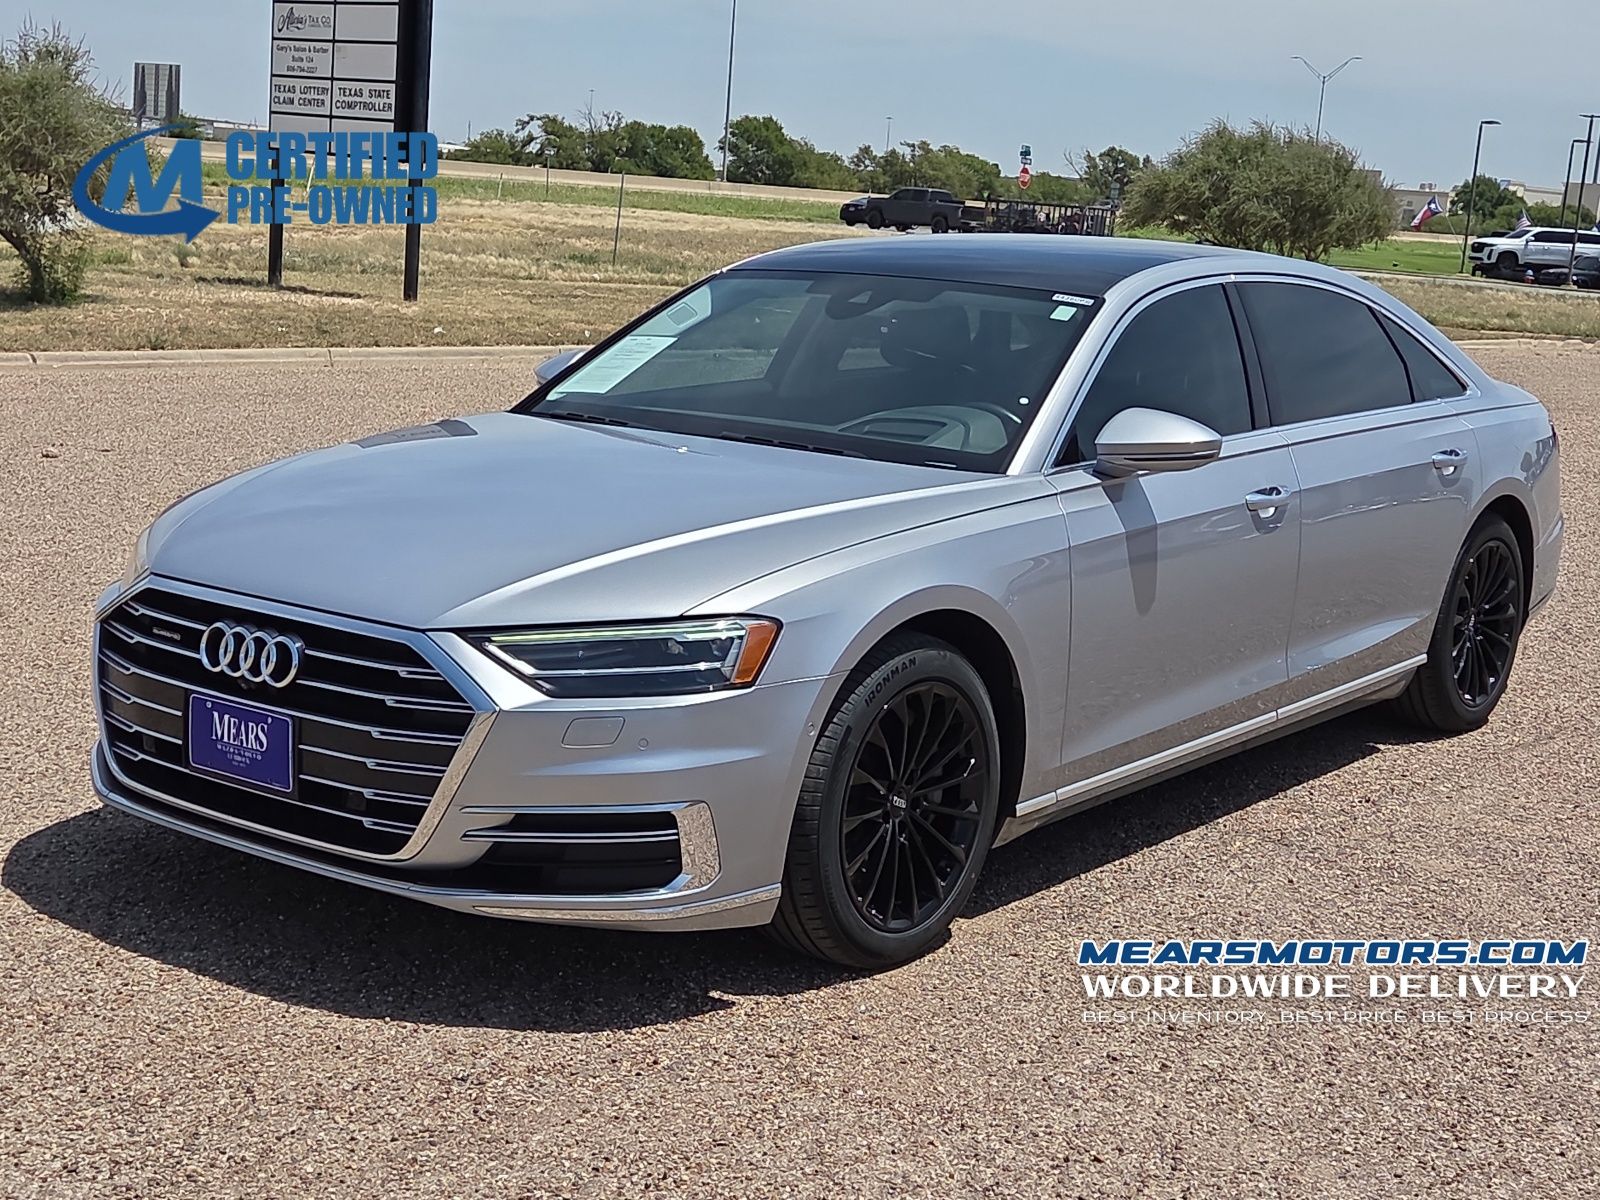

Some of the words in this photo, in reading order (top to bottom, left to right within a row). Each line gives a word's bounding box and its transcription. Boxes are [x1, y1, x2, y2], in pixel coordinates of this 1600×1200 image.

[274, 84, 296, 94] TEXAS
[299, 86, 329, 96] LOTTERY
[338, 87, 364, 98] TEXAS
[368, 89, 391, 100] STATE
[273, 96, 295, 106] CLAIM
[298, 97, 326, 108] CENTER
[335, 100, 393, 112] COMPTROLLER
[864, 656, 917, 707] IRONMAN
[211, 711, 268, 752] MEARS
